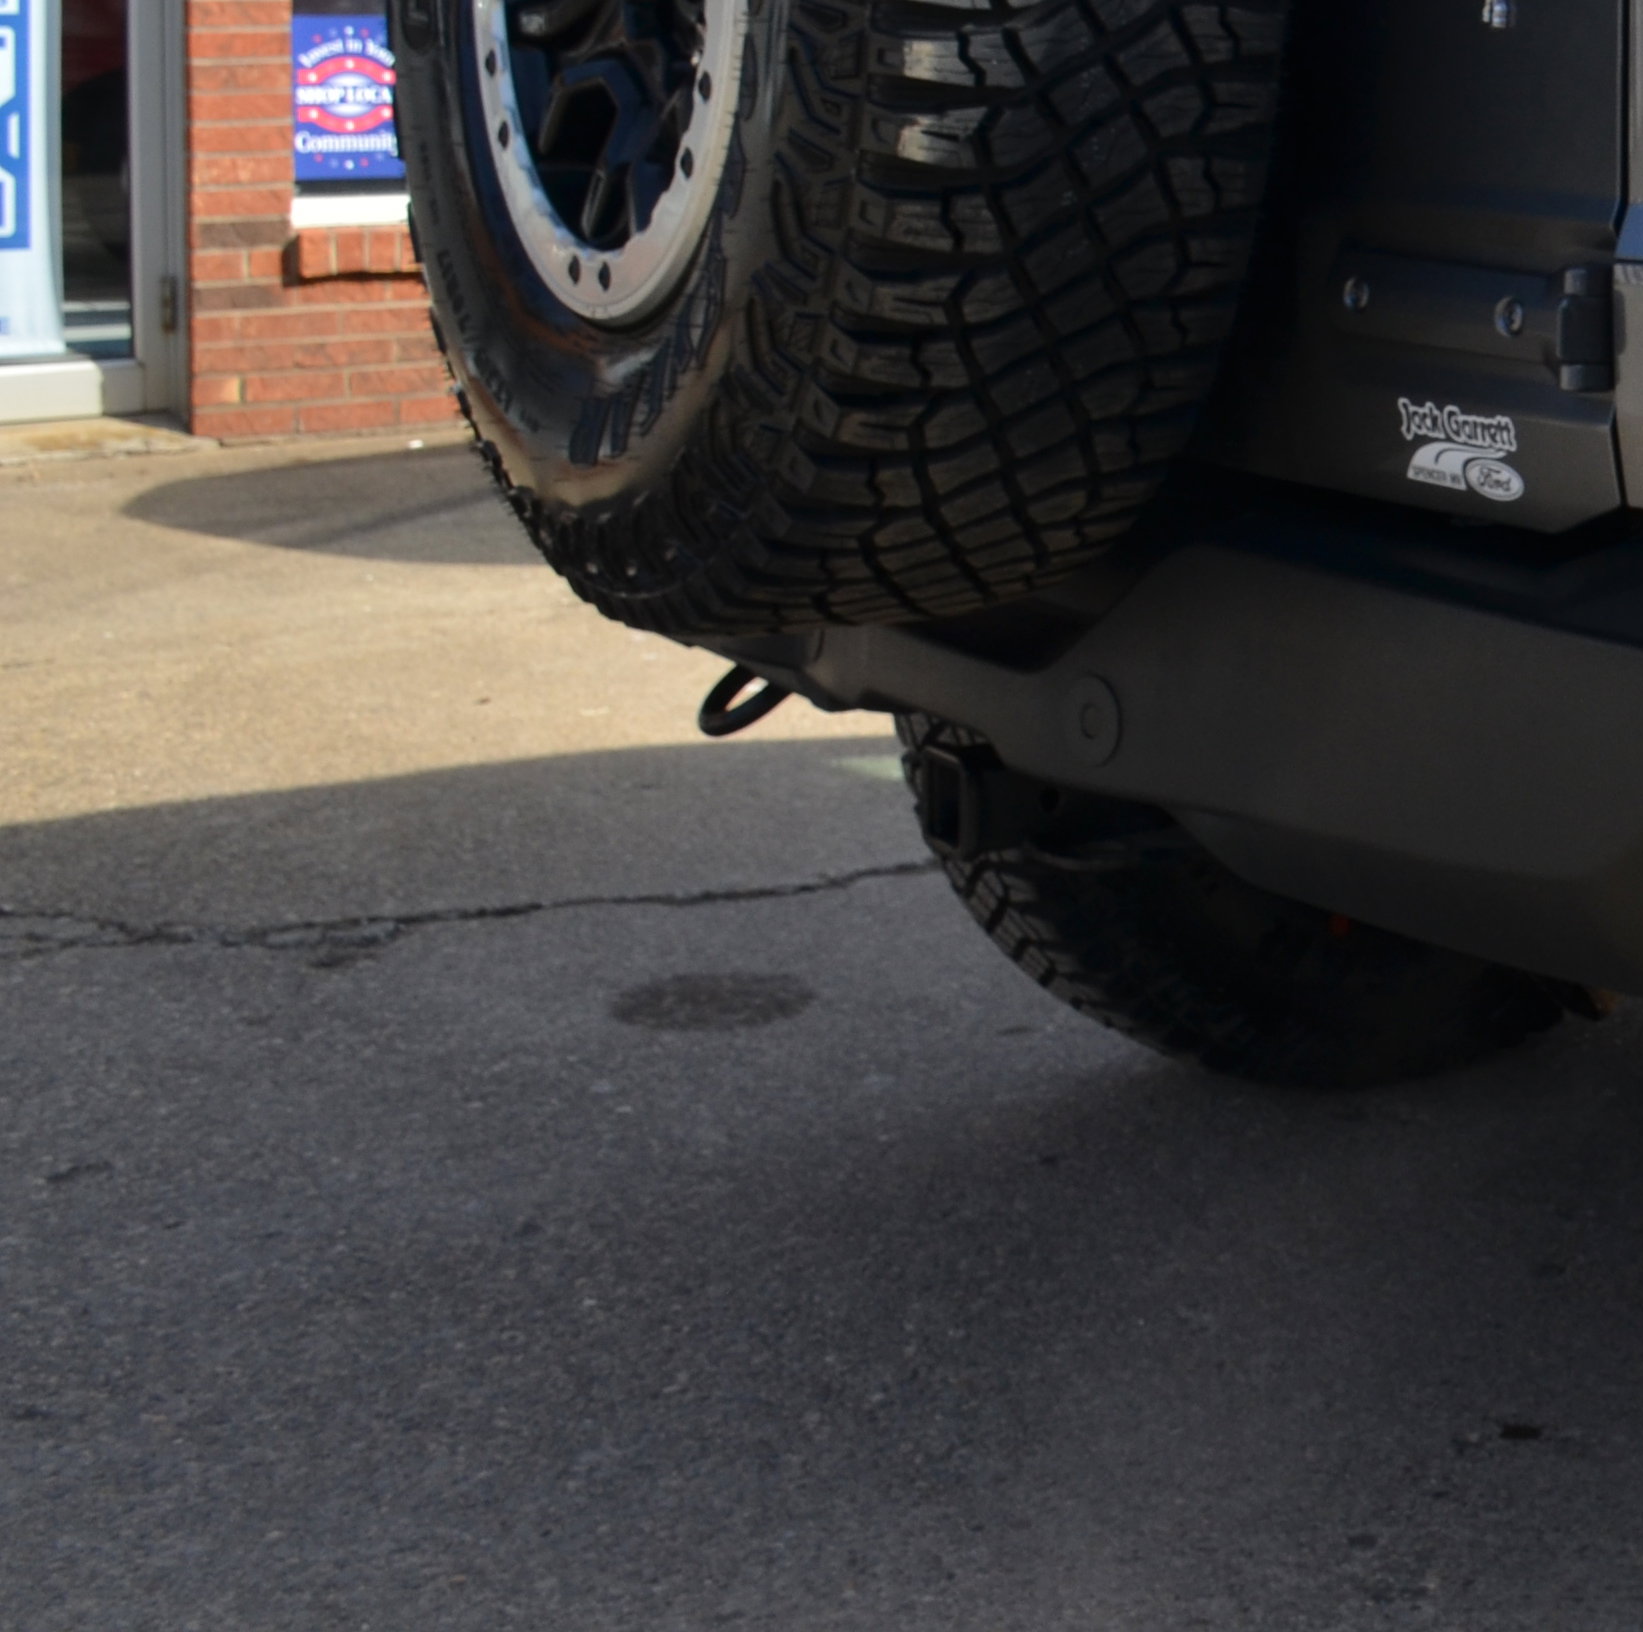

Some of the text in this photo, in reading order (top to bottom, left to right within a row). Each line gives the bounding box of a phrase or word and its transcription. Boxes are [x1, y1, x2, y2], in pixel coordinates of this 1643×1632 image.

[346, 86, 394, 104] LOCA
[1398, 397, 1517, 452] Jack Garrett
[1477, 465, 1513, 493] Ford
